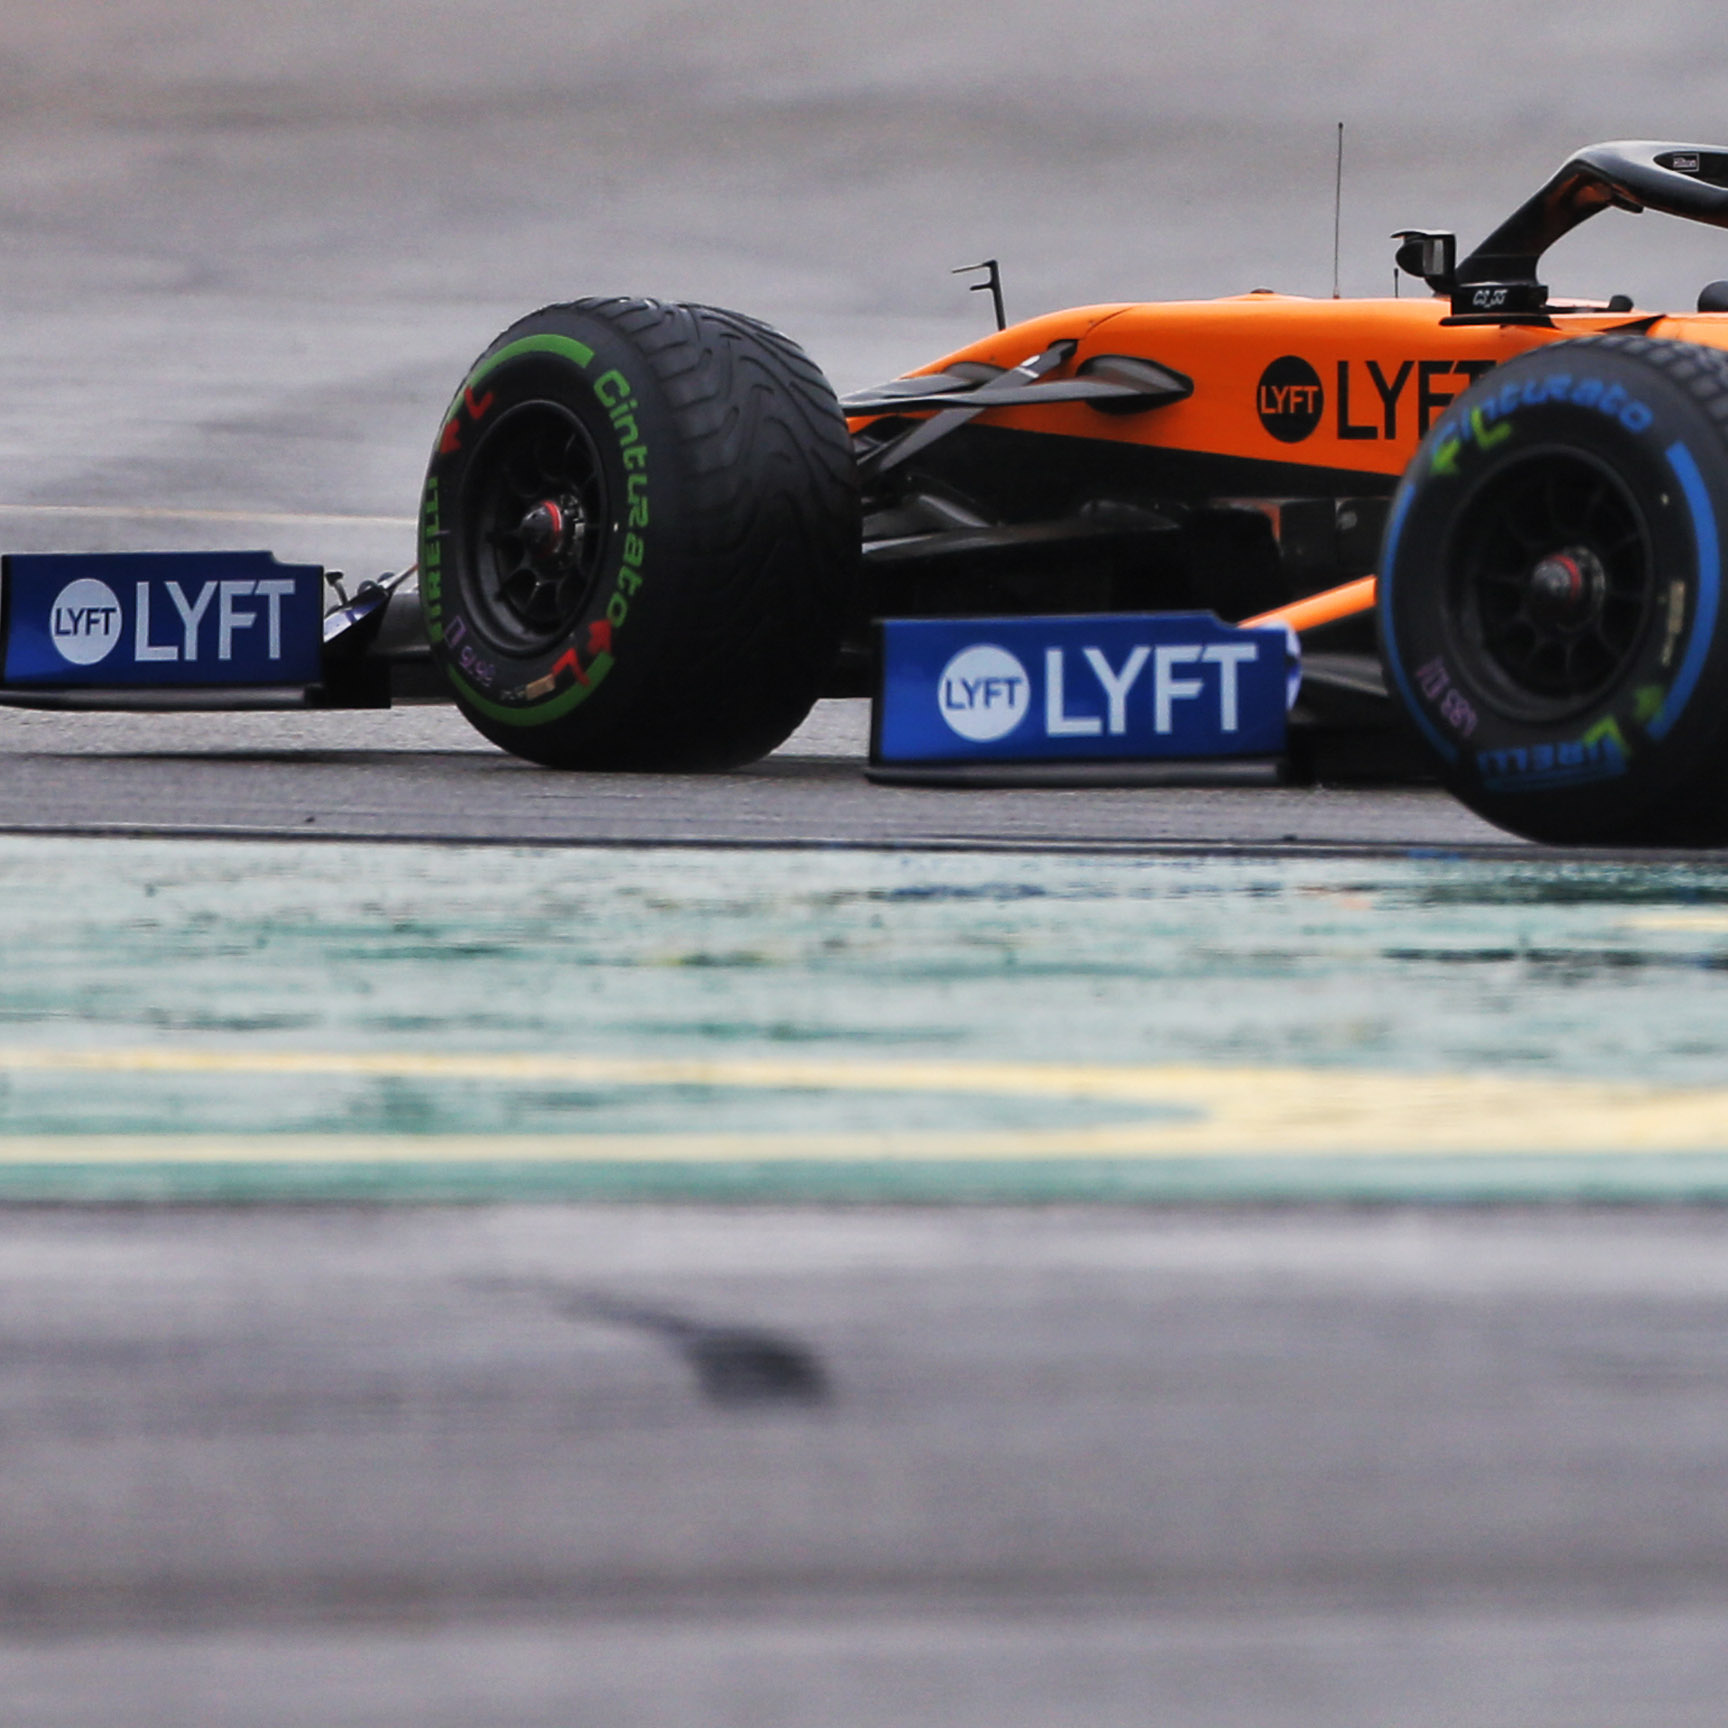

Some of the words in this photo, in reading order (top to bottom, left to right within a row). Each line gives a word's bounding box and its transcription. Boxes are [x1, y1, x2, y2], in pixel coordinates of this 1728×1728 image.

[1260, 385, 1319, 414] LYFT
[593, 369, 650, 630] Cinturato
[54, 606, 117, 636] LYFT
[135, 579, 294, 661] LYFT
[944, 678, 1021, 710] LYFT
[1046, 645, 1257, 736] LYFT
